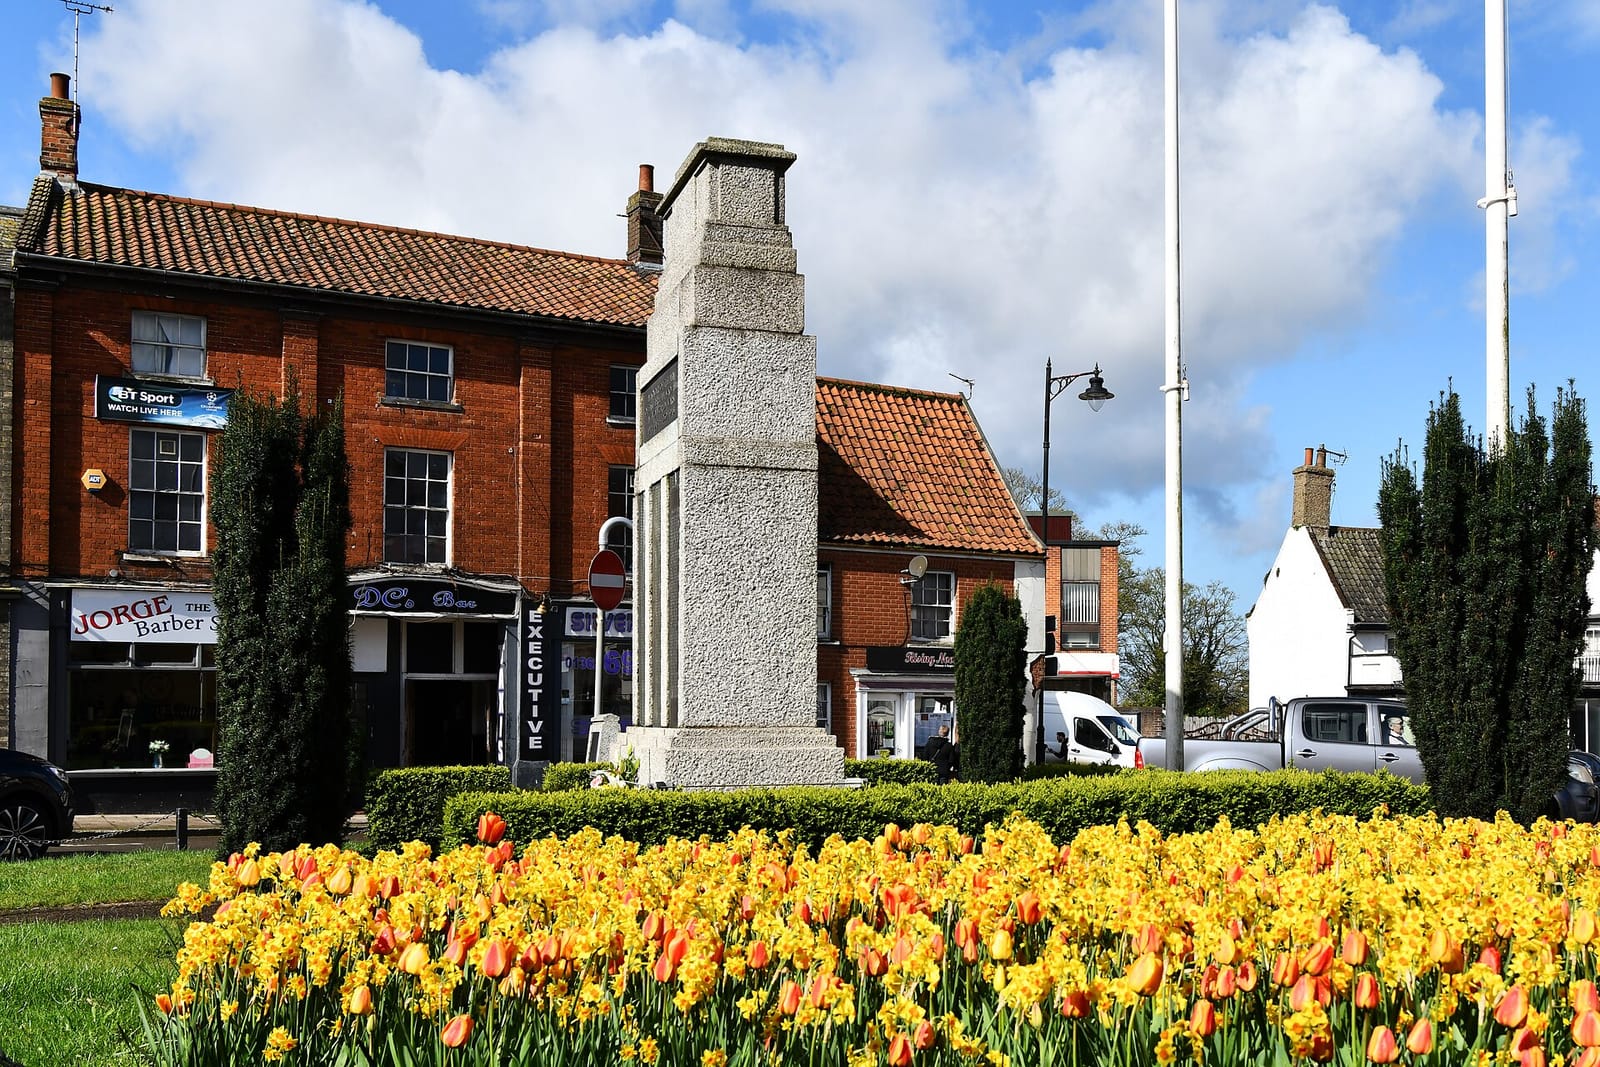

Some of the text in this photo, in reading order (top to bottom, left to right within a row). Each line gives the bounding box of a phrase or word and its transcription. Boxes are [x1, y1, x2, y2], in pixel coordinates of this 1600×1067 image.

[118, 390, 175, 405] BT Sport
[108, 403, 183, 417] WATCH LIVE HERE
[353, 586, 478, 609] DC's Bar
[74, 595, 212, 635] JORGE THE
[134, 614, 204, 638] Barber
[527, 609, 544, 750] EXECUTIVE
